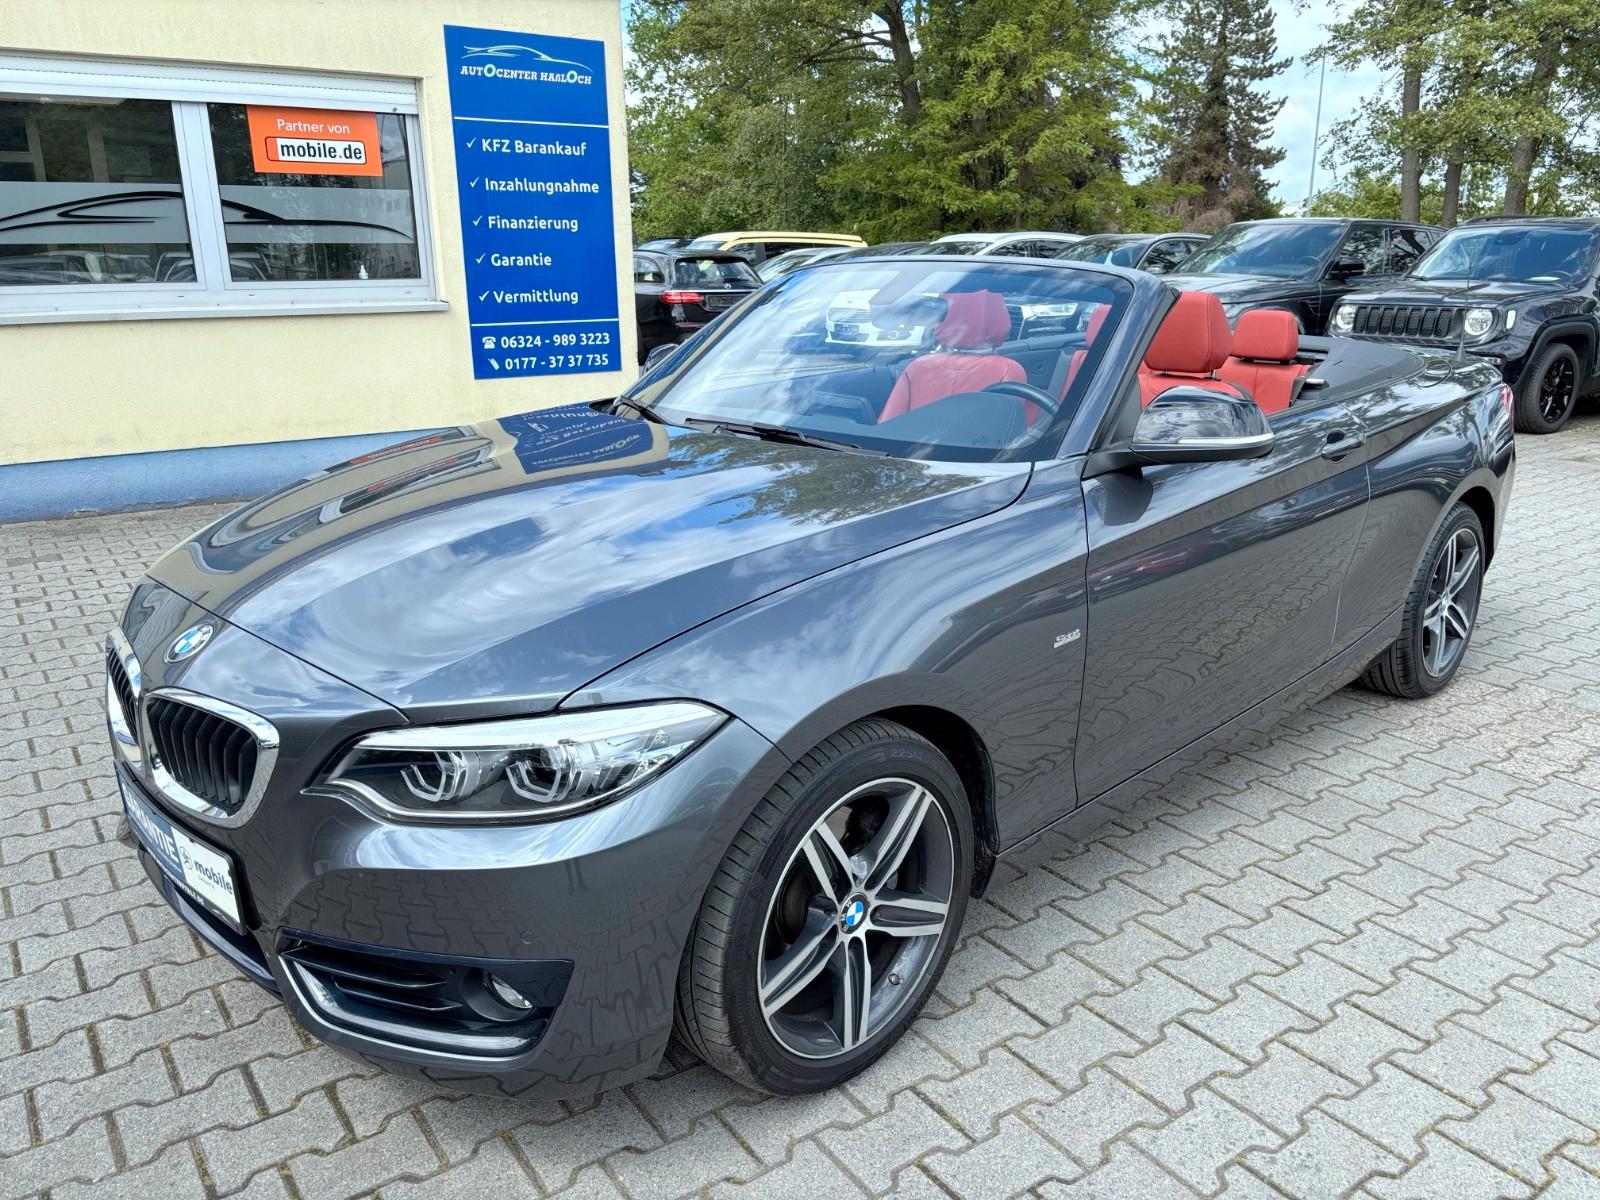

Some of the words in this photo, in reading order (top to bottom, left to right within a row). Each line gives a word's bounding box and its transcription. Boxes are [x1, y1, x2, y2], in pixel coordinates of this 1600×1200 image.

[460, 64, 538, 81] AUTOCENTER
[276, 118, 323, 133] Partner
[327, 125, 350, 134] von
[280, 142, 362, 160] mobile.de
[481, 138, 511, 153] KFZ
[515, 140, 587, 156] Barankauf
[485, 177, 600, 195] Inzahlungnahme
[488, 215, 579, 232] Finanzierung
[491, 253, 552, 267] Garantie
[493, 289, 579, 304] Vermittlung
[501, 335, 542, 349] 06324
[553, 334, 577, 346] 989
[580, 333, 610, 345] 3223
[505, 357, 537, 370] 0177
[549, 355, 564, 368] 37
[568, 354, 583, 367] 37
[586, 353, 609, 366] 735
[194, 860, 233, 895] mobile
